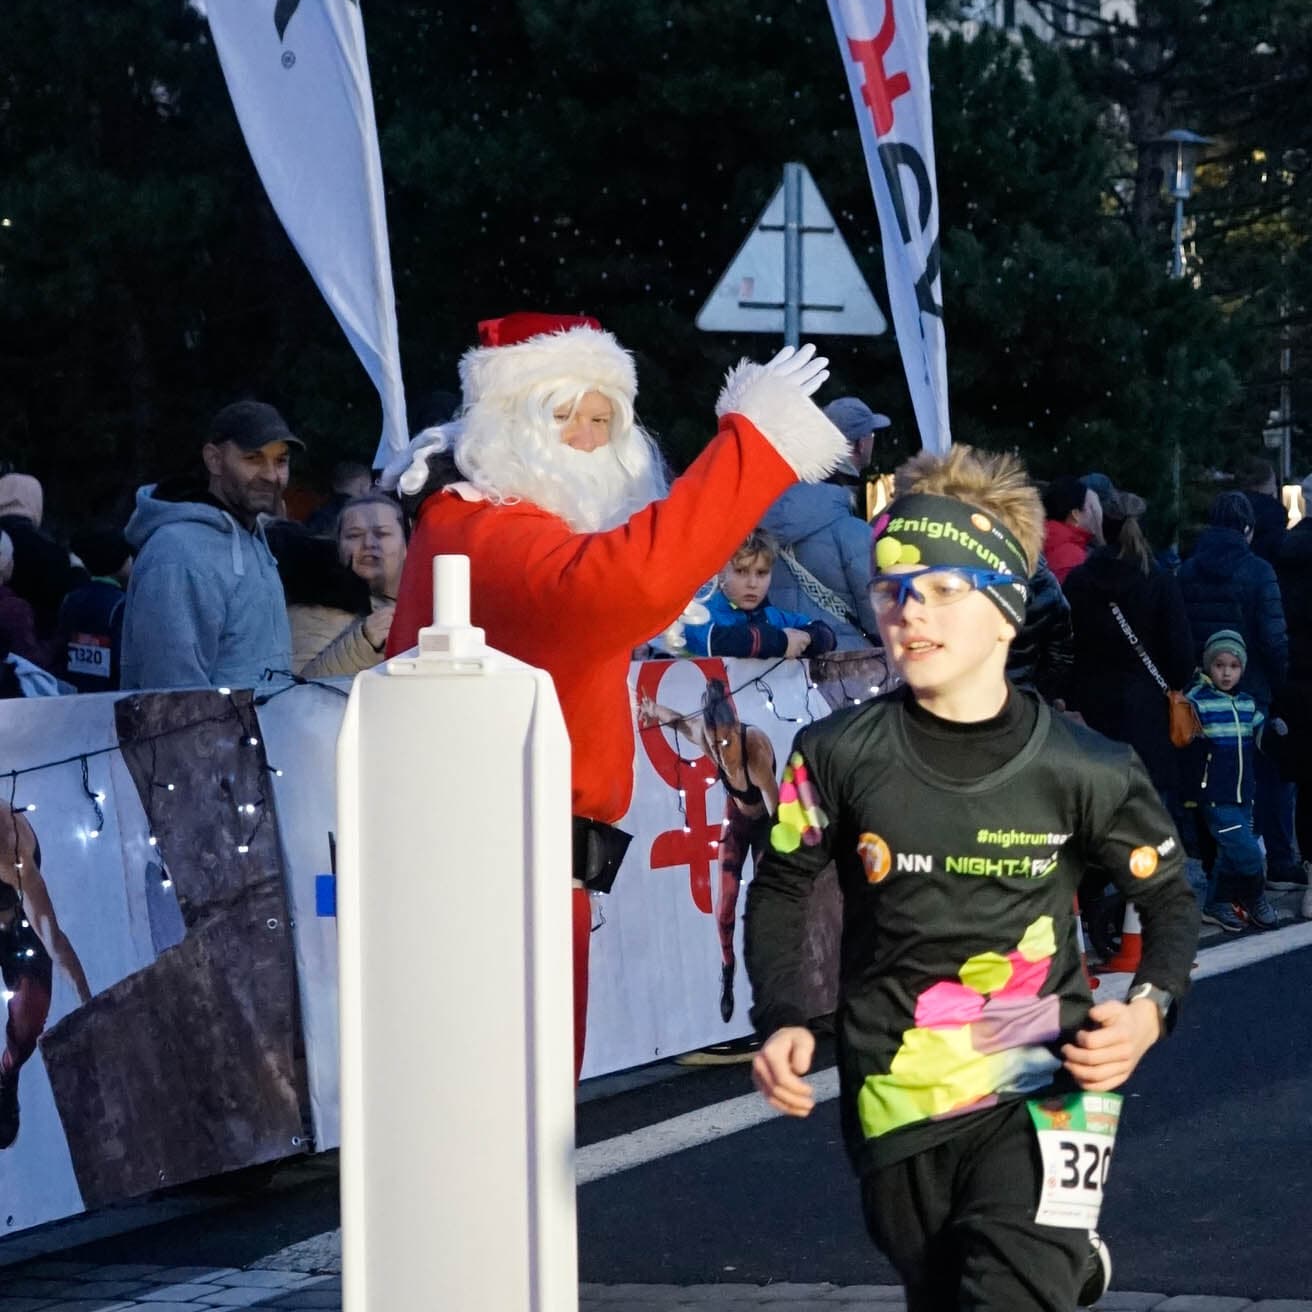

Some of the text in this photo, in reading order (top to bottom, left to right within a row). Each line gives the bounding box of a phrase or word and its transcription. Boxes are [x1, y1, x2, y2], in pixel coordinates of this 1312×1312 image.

[976, 828, 1071, 849] #nightruntea
[896, 852, 933, 873] NN
[945, 855, 1020, 877] NIGHT
